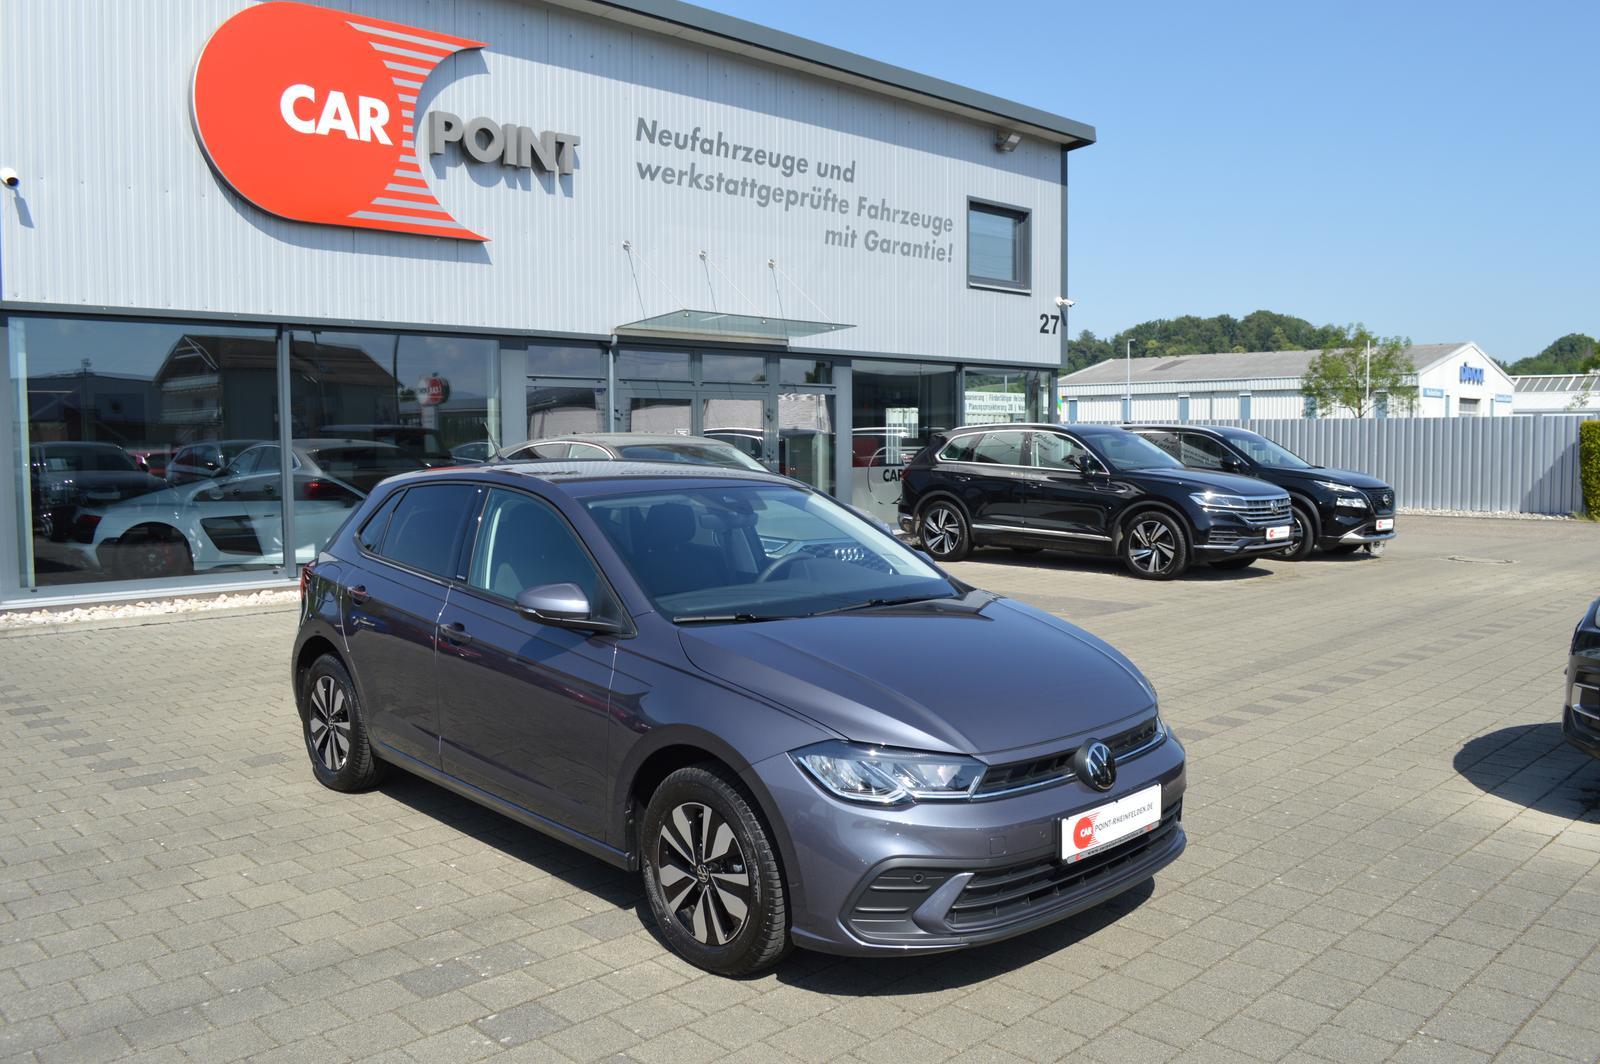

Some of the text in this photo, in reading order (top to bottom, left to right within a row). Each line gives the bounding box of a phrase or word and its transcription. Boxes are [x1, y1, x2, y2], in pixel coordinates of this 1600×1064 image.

[280, 83, 580, 175] CAR POINT
[636, 117, 856, 183] Neufahrzeuge und
[636, 161, 953, 236] werkstattgeprüfte Fahrzeuge
[825, 225, 953, 263] mit Garantie!
[1040, 313, 1060, 335] 27
[1080, 825, 1093, 837] CAR
